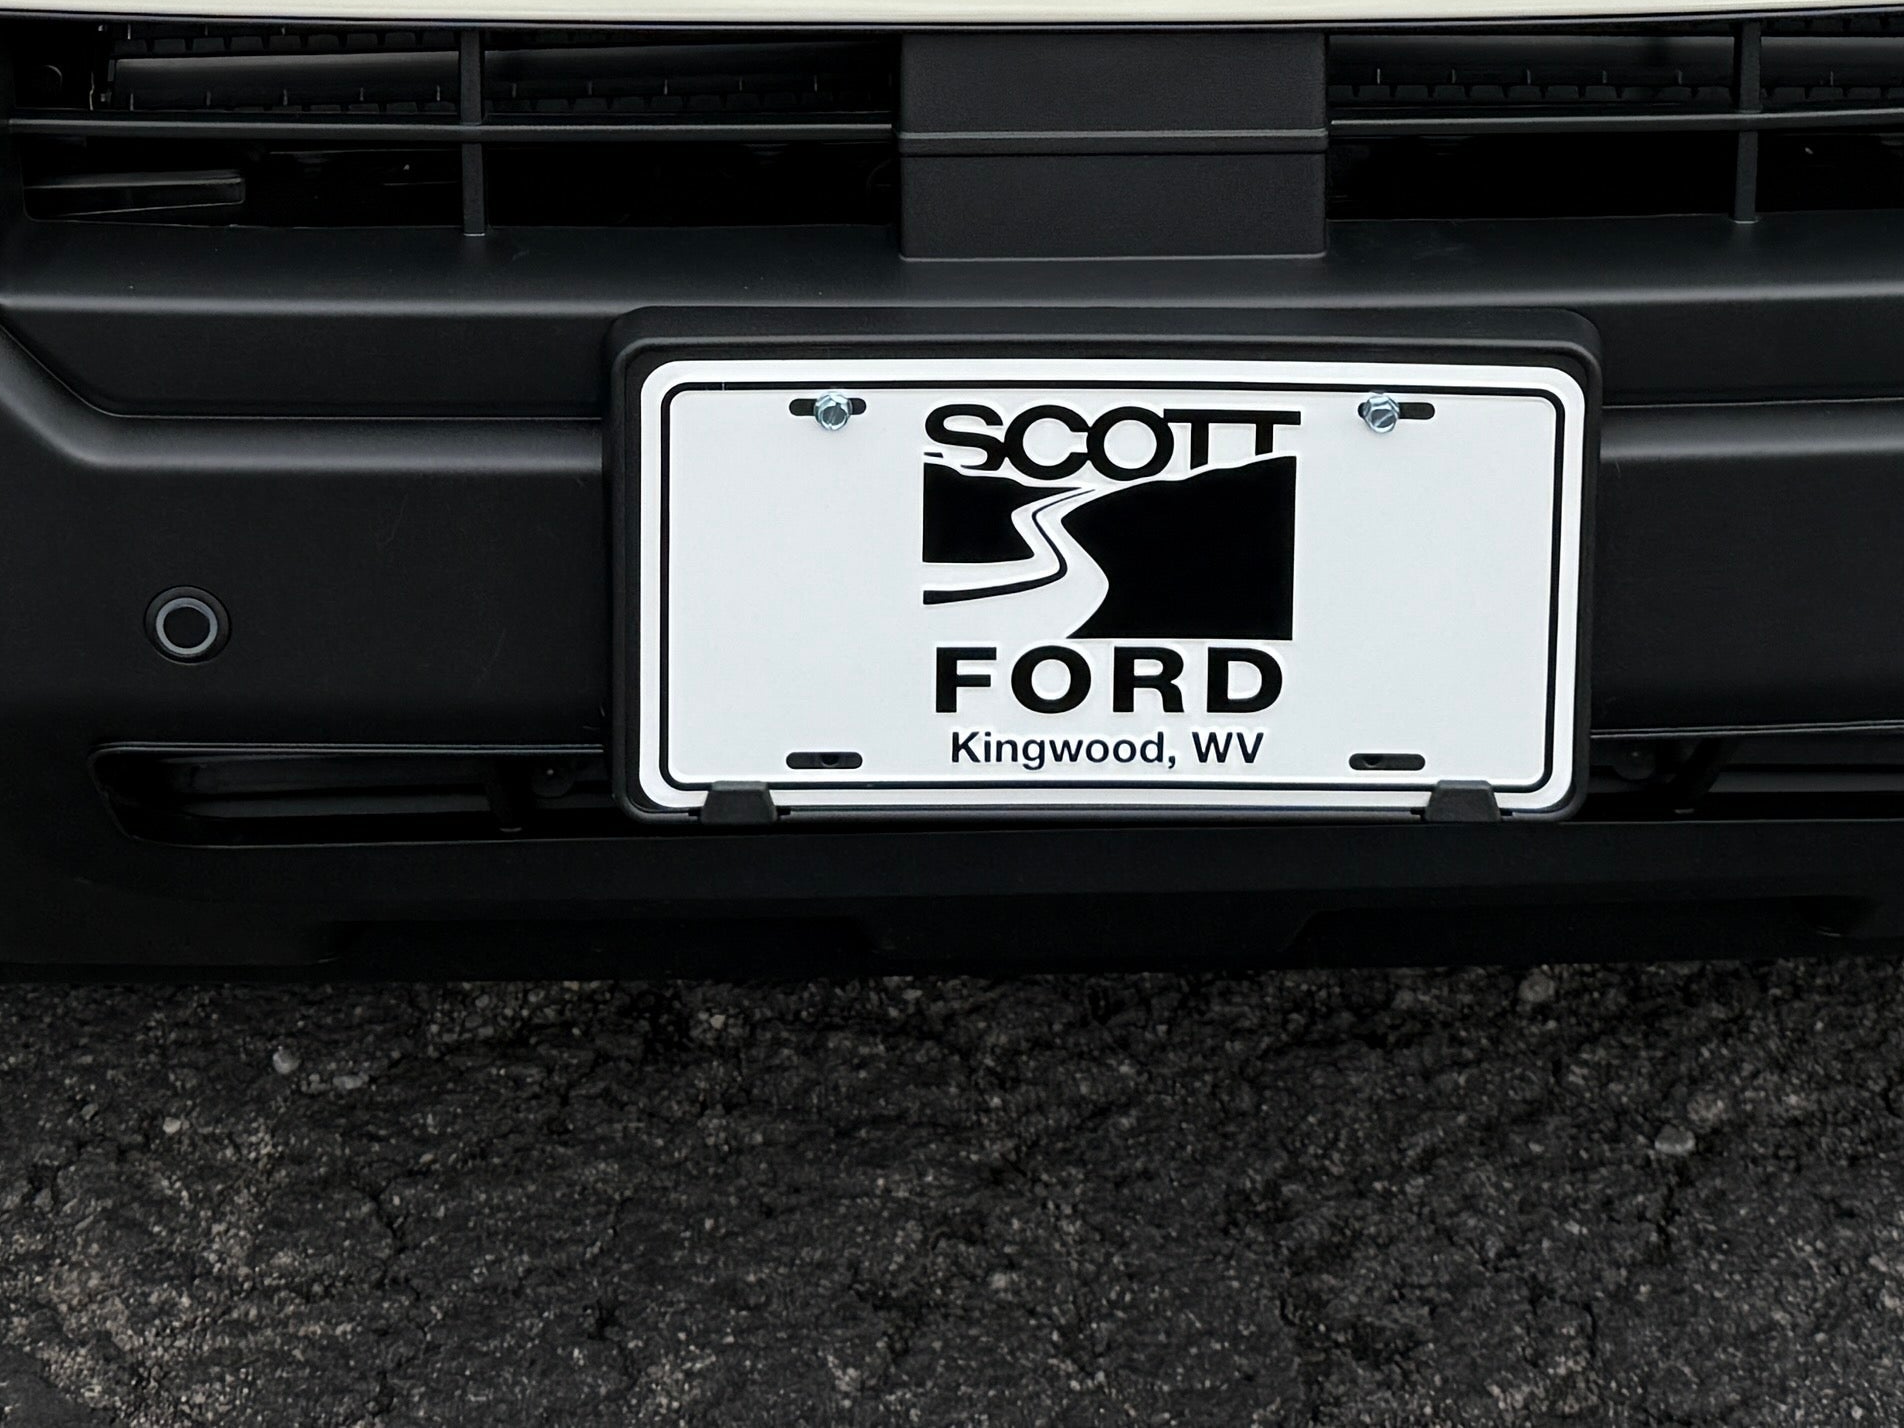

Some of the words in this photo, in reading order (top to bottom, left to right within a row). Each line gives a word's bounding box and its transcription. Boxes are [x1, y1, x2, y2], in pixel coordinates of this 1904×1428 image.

[924, 403, 1302, 481] SCOTT
[935, 645, 1283, 715] FORD
[951, 731, 1176, 771] Kingwood,
[1191, 731, 1264, 764] WV
